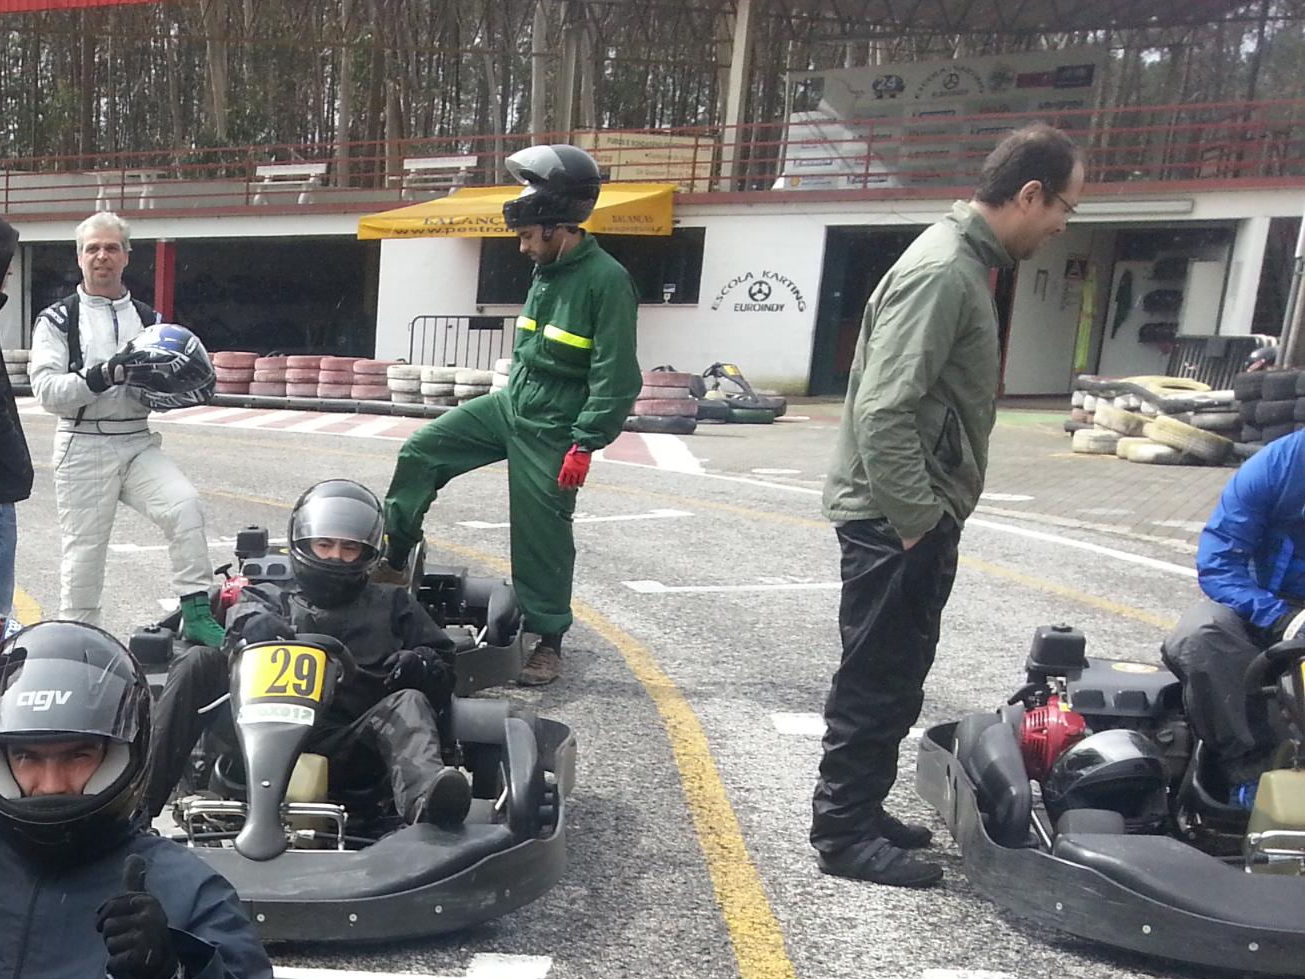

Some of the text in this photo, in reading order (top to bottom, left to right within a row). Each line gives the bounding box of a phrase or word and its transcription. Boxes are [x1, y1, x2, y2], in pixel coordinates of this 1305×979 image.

[711, 270, 807, 312] ESCOLA KARTING
[733, 303, 785, 312] EUROINDY
[265, 647, 318, 696] 29
[16, 690, 72, 712] agv
